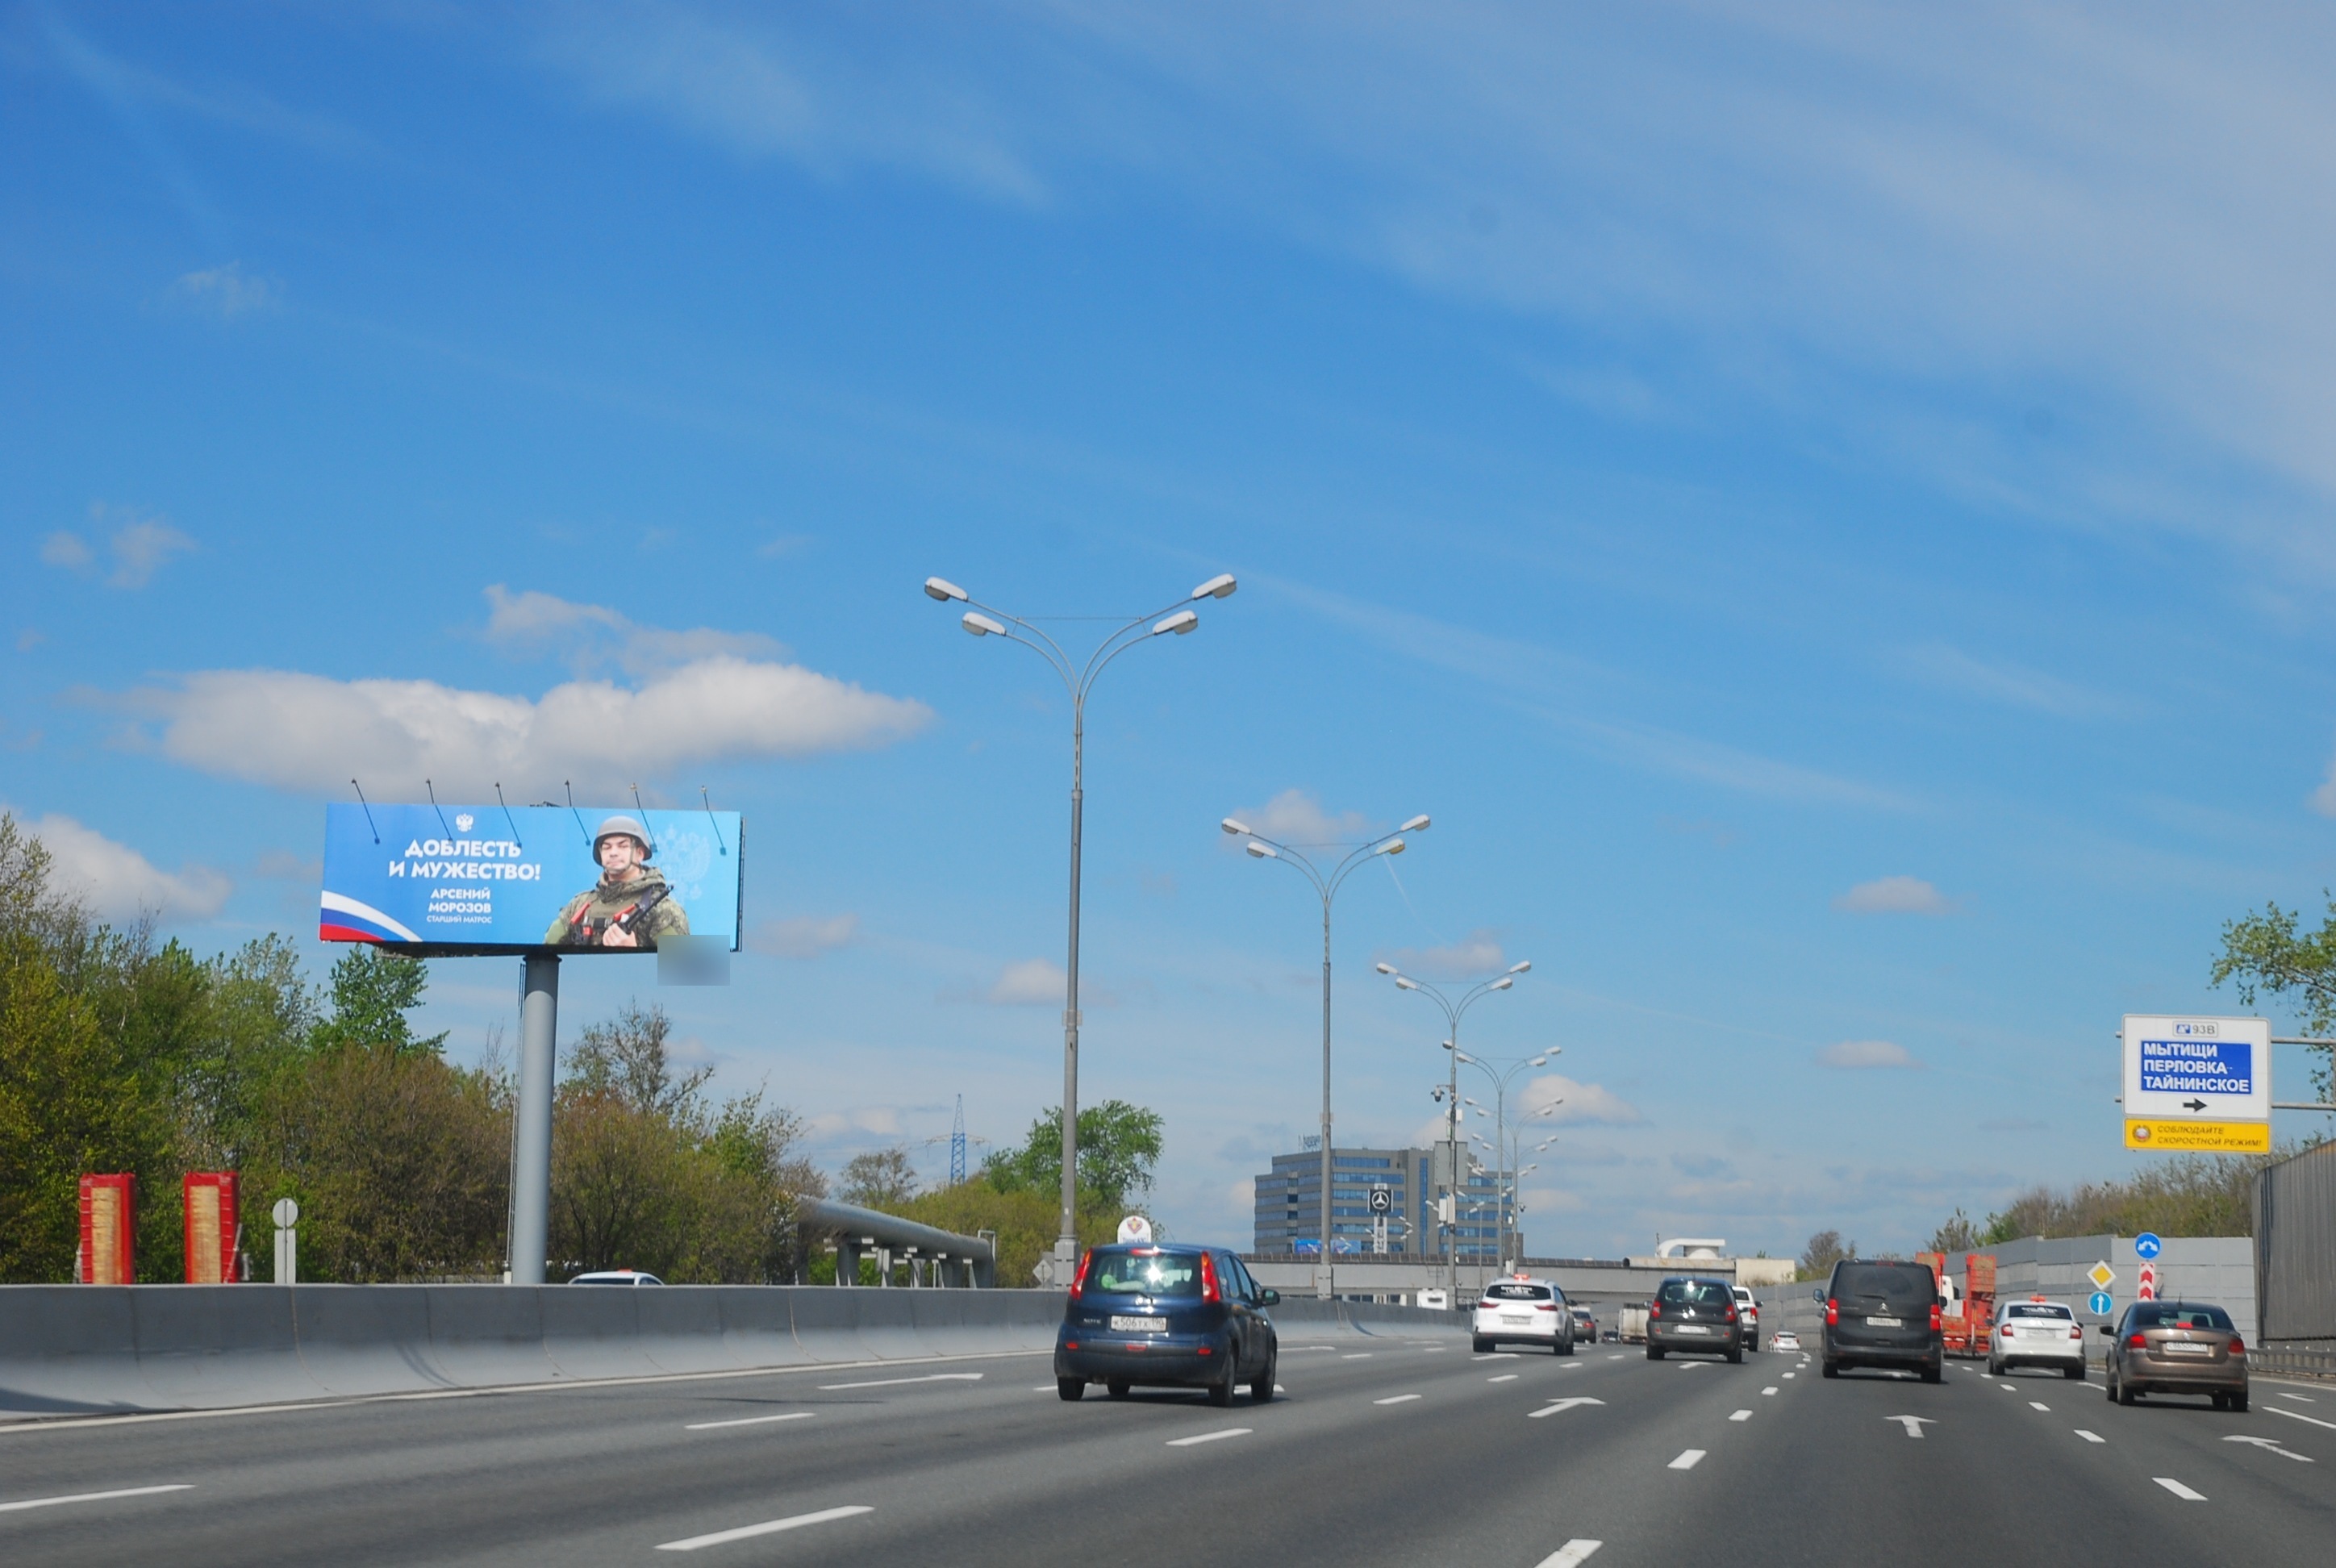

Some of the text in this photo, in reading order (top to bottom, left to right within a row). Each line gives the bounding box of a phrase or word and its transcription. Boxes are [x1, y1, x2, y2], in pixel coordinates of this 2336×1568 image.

[404, 839, 522, 857] ДОБЛЕСТЬ
[389, 861, 541, 881] И МУЖЕСТВО!
[430, 886, 491, 899] АРСЕНИЙ
[428, 902, 491, 913] МОРОЗОВ
[427, 915, 492, 924] СТАРШИЙ МАТРОС
[2143, 1042, 2217, 1058] МЫТИЩИ
[2143, 1060, 2228, 1074] ПЕРЛОВКА
[2143, 1074, 2250, 1093] ТАЙНИНСКОЕ
[2157, 1125, 2225, 1134] СОБЛЮДАЙТЕ
[2157, 1136, 2221, 1145] СКОРОСТНОЙ
